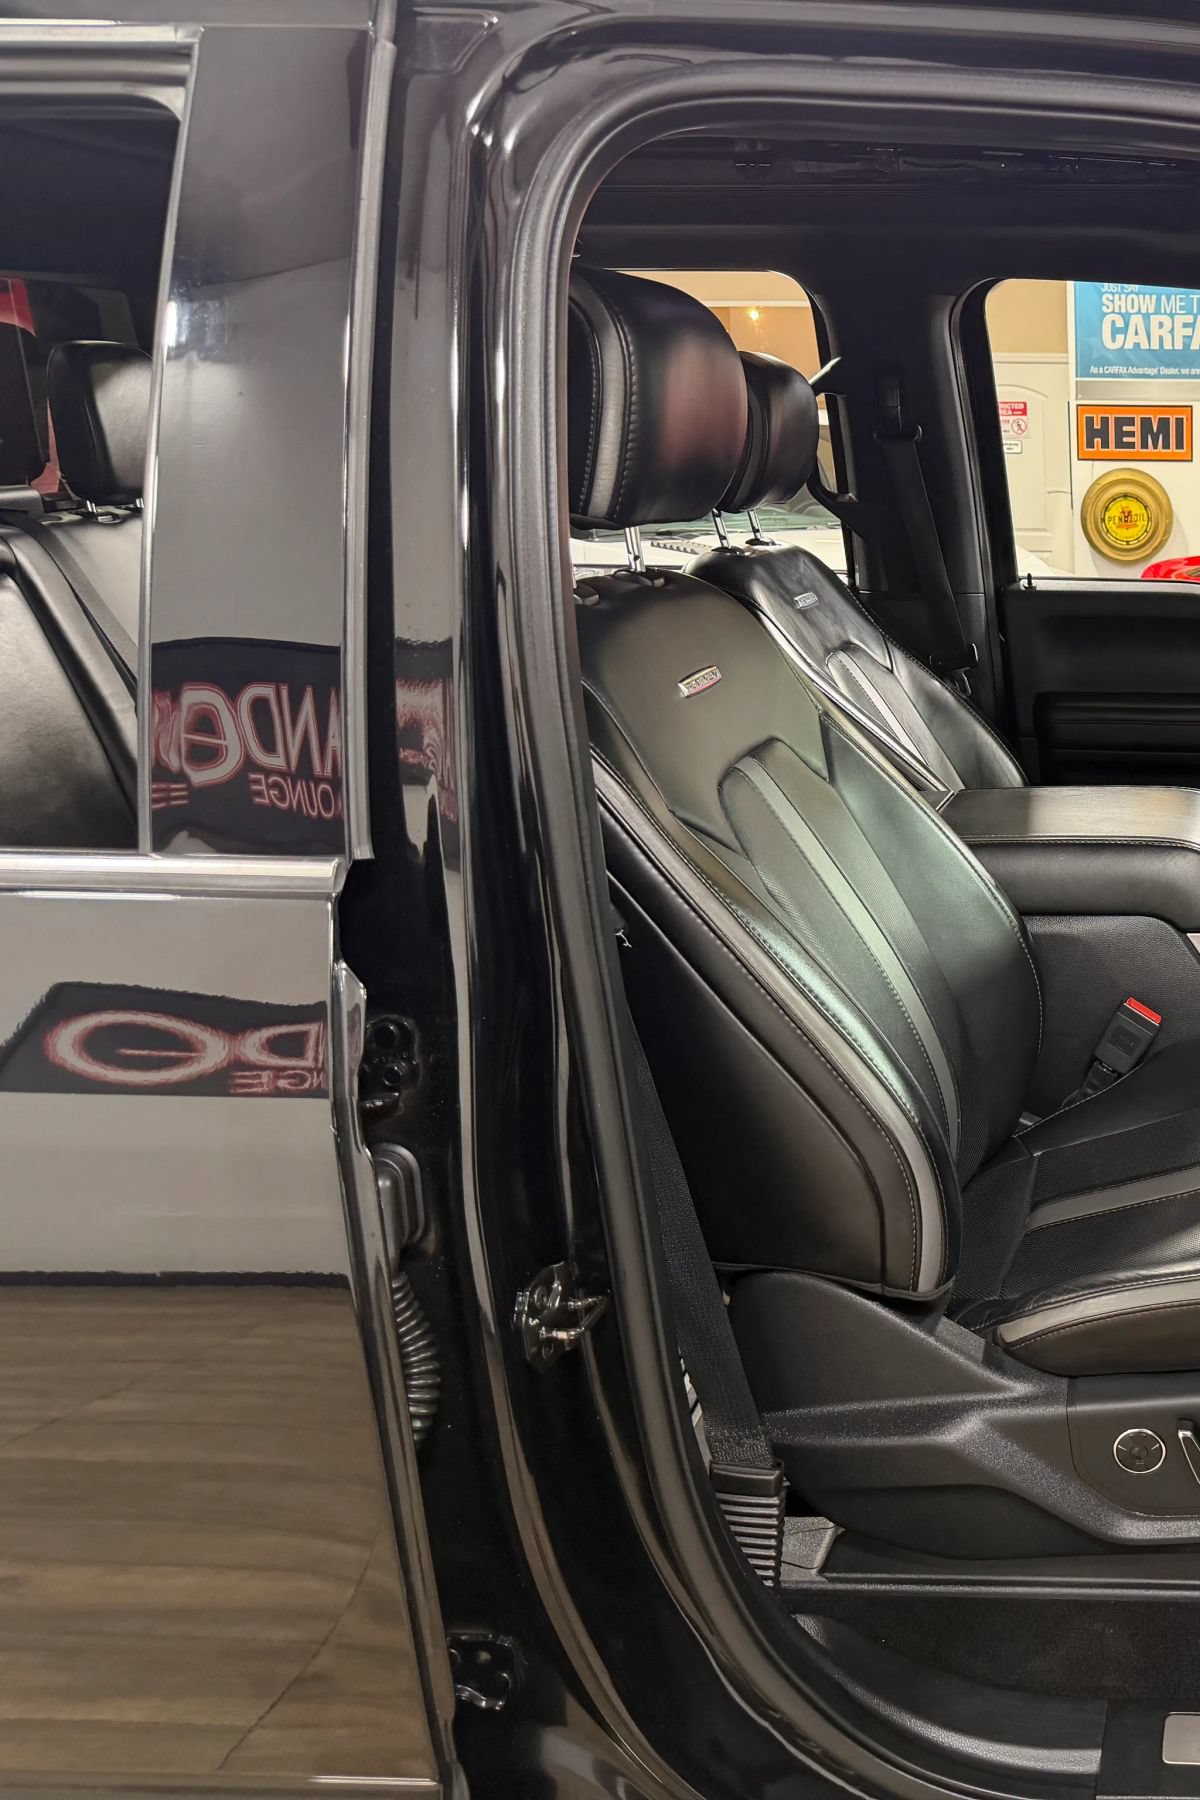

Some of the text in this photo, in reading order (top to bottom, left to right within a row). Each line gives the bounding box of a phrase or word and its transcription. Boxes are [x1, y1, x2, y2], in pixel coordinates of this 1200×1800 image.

[1102, 294, 1157, 314] SHOW
[1161, 295, 1187, 314] ME
[1104, 366, 1128, 374] CARFAX
[1084, 415, 1185, 452] HEMI
